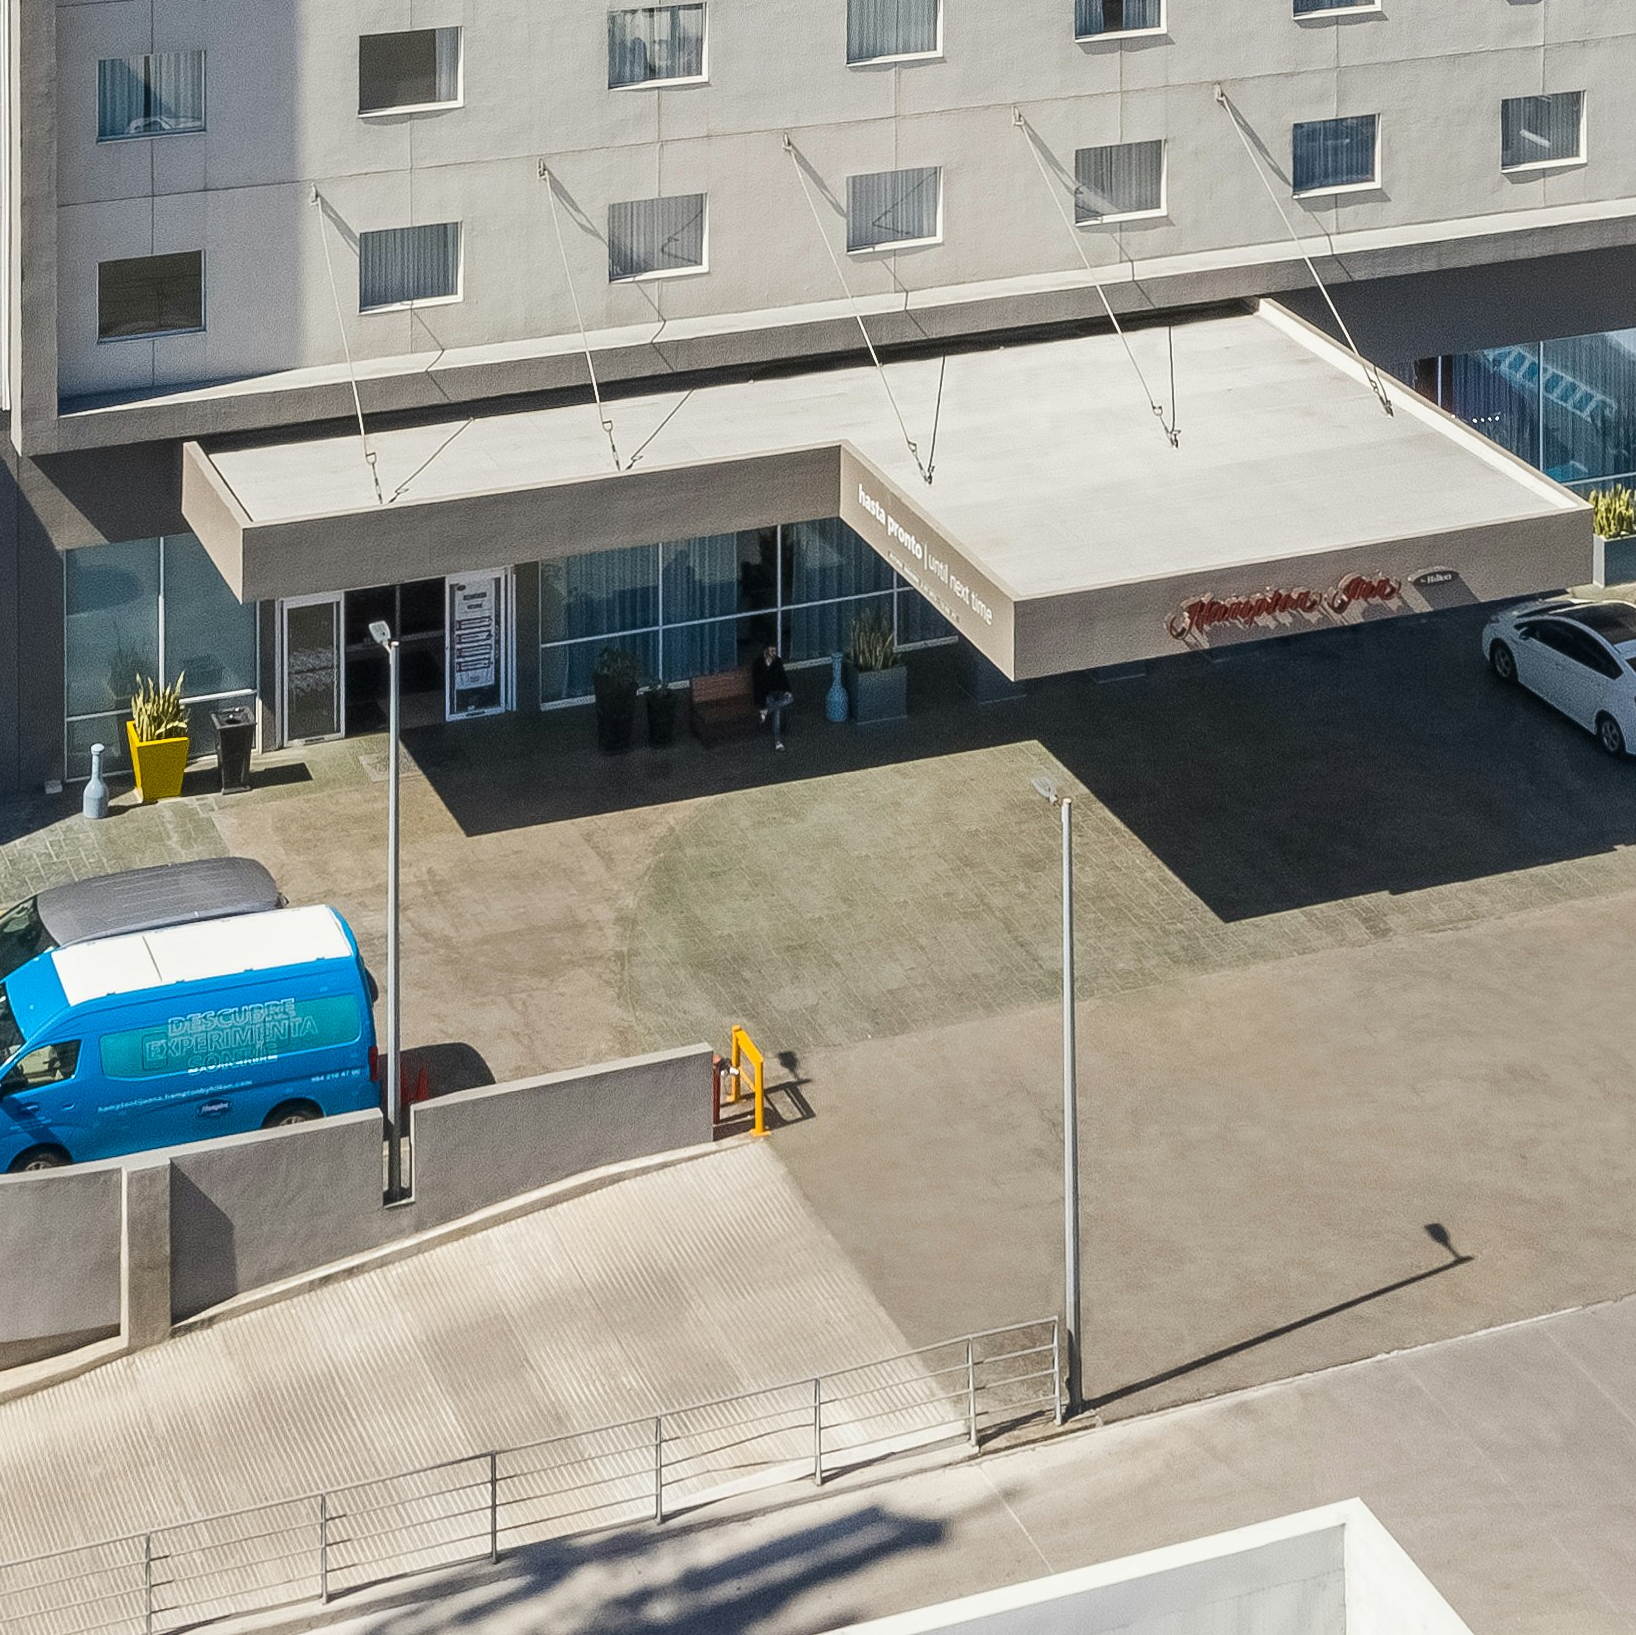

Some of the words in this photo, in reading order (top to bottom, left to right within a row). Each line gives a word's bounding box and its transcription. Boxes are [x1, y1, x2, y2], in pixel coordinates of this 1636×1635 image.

[857, 483, 886, 526] hasta
[887, 514, 923, 560] pronto
[928, 554, 949, 586] until
[949, 574, 970, 606] next
[971, 592, 994, 626] time
[1169, 590, 1321, 640] Hampton
[145, 1015, 319, 1062] EXPERIMENTA
[168, 997, 296, 1038] DESCUBRE
